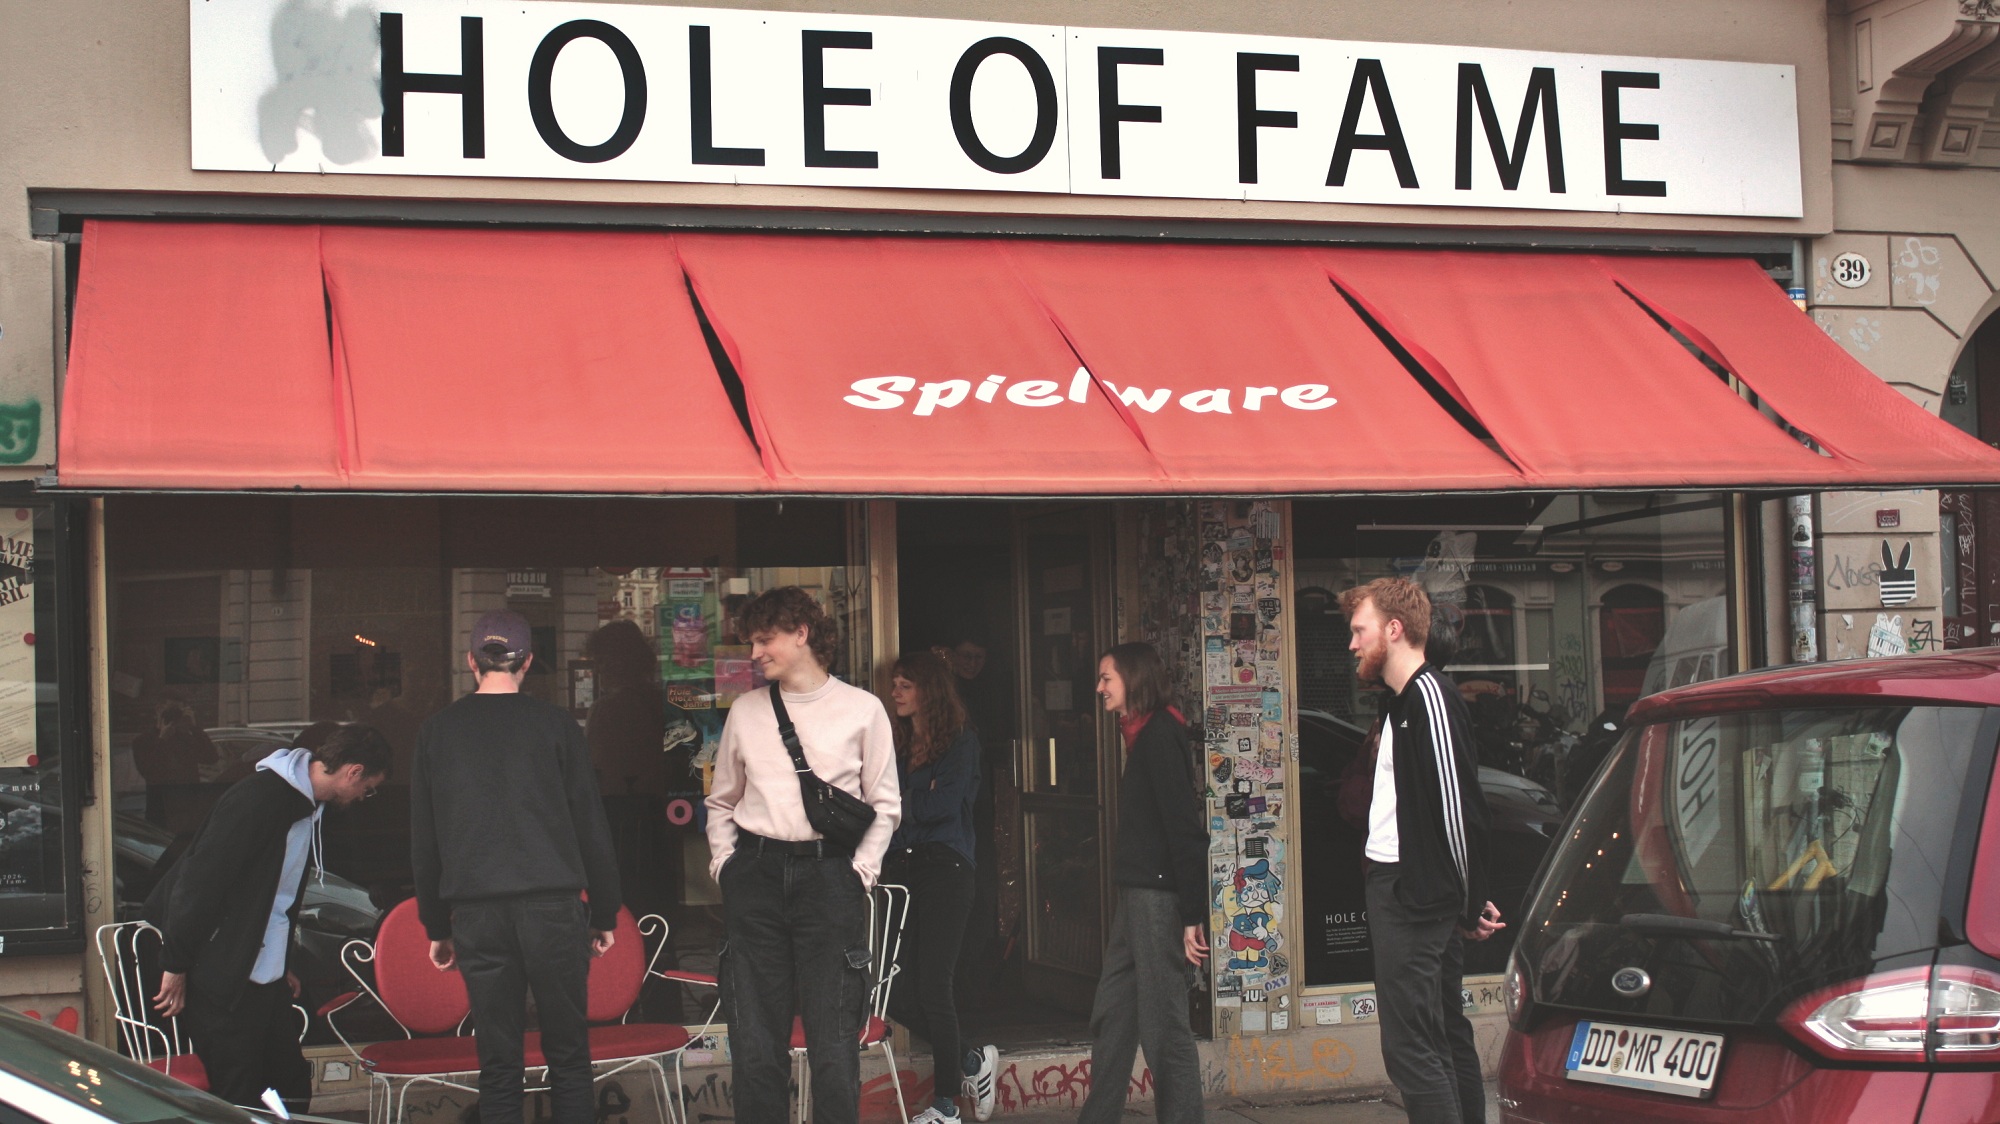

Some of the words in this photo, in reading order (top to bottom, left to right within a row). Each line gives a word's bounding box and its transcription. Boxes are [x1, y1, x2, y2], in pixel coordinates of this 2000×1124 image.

[380, 12, 878, 169] HOLE
[949, 36, 1164, 179] OF
[1237, 52, 1667, 197] FAME
[1839, 258, 1865, 282] 39
[843, 366, 1338, 416] Spielware
[1325, 912, 1357, 924] HOLE
[1265, 976, 1287, 991] OXY
[1581, 1028, 1616, 1067] DD
[1625, 1033, 1662, 1074] MR
[1664, 1038, 1717, 1080] 400
